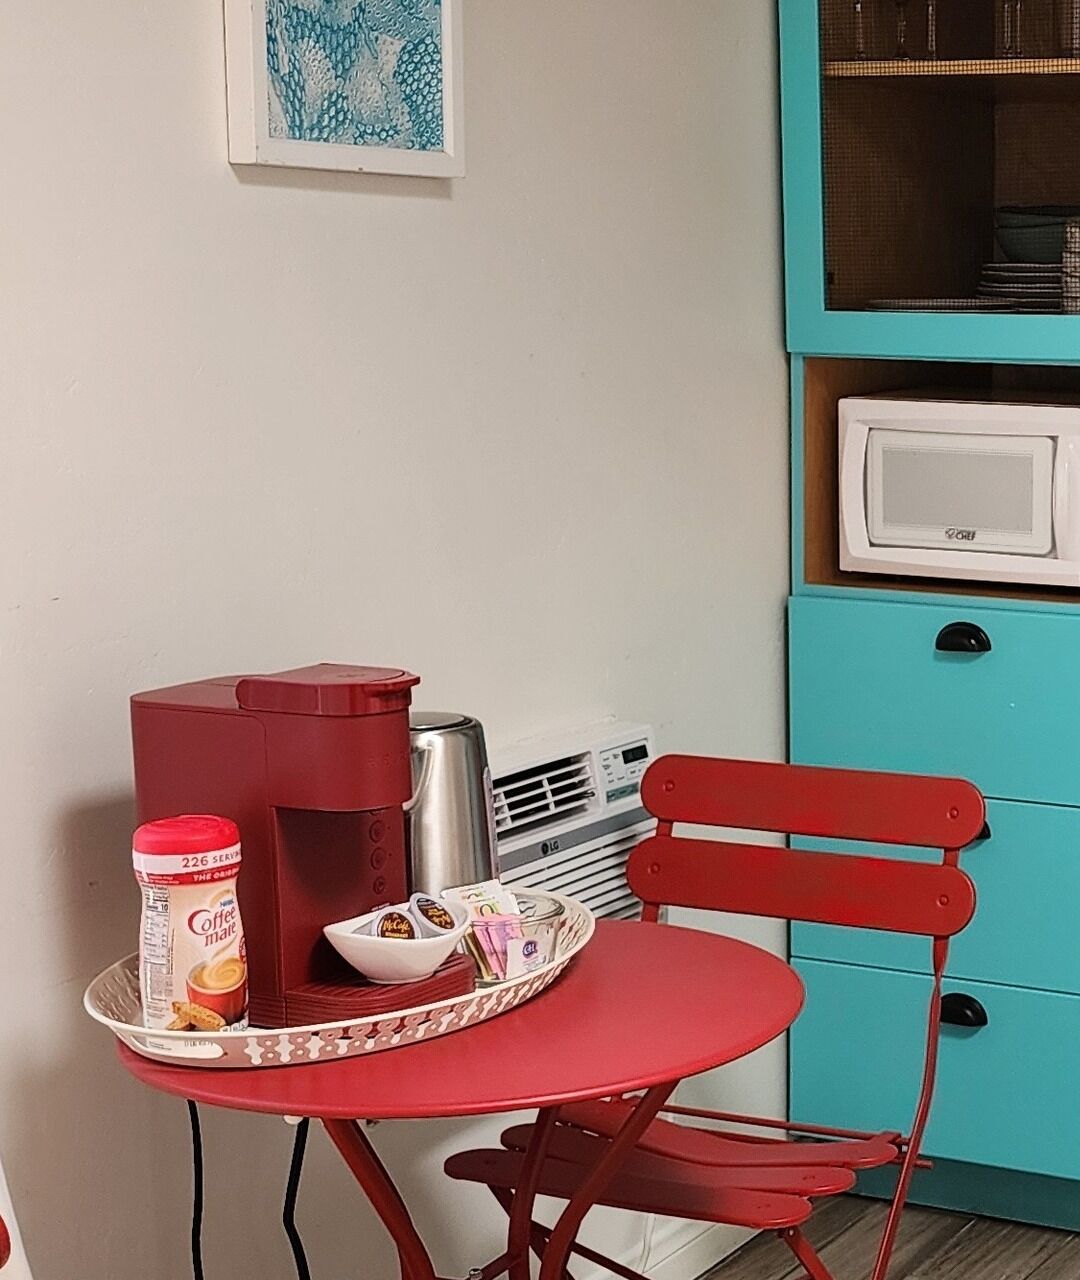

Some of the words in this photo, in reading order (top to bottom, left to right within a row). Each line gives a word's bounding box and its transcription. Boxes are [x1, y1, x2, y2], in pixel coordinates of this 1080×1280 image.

[182, 855, 209, 869] 226
[188, 906, 236, 936] Coffee
[205, 922, 236, 947] mate
